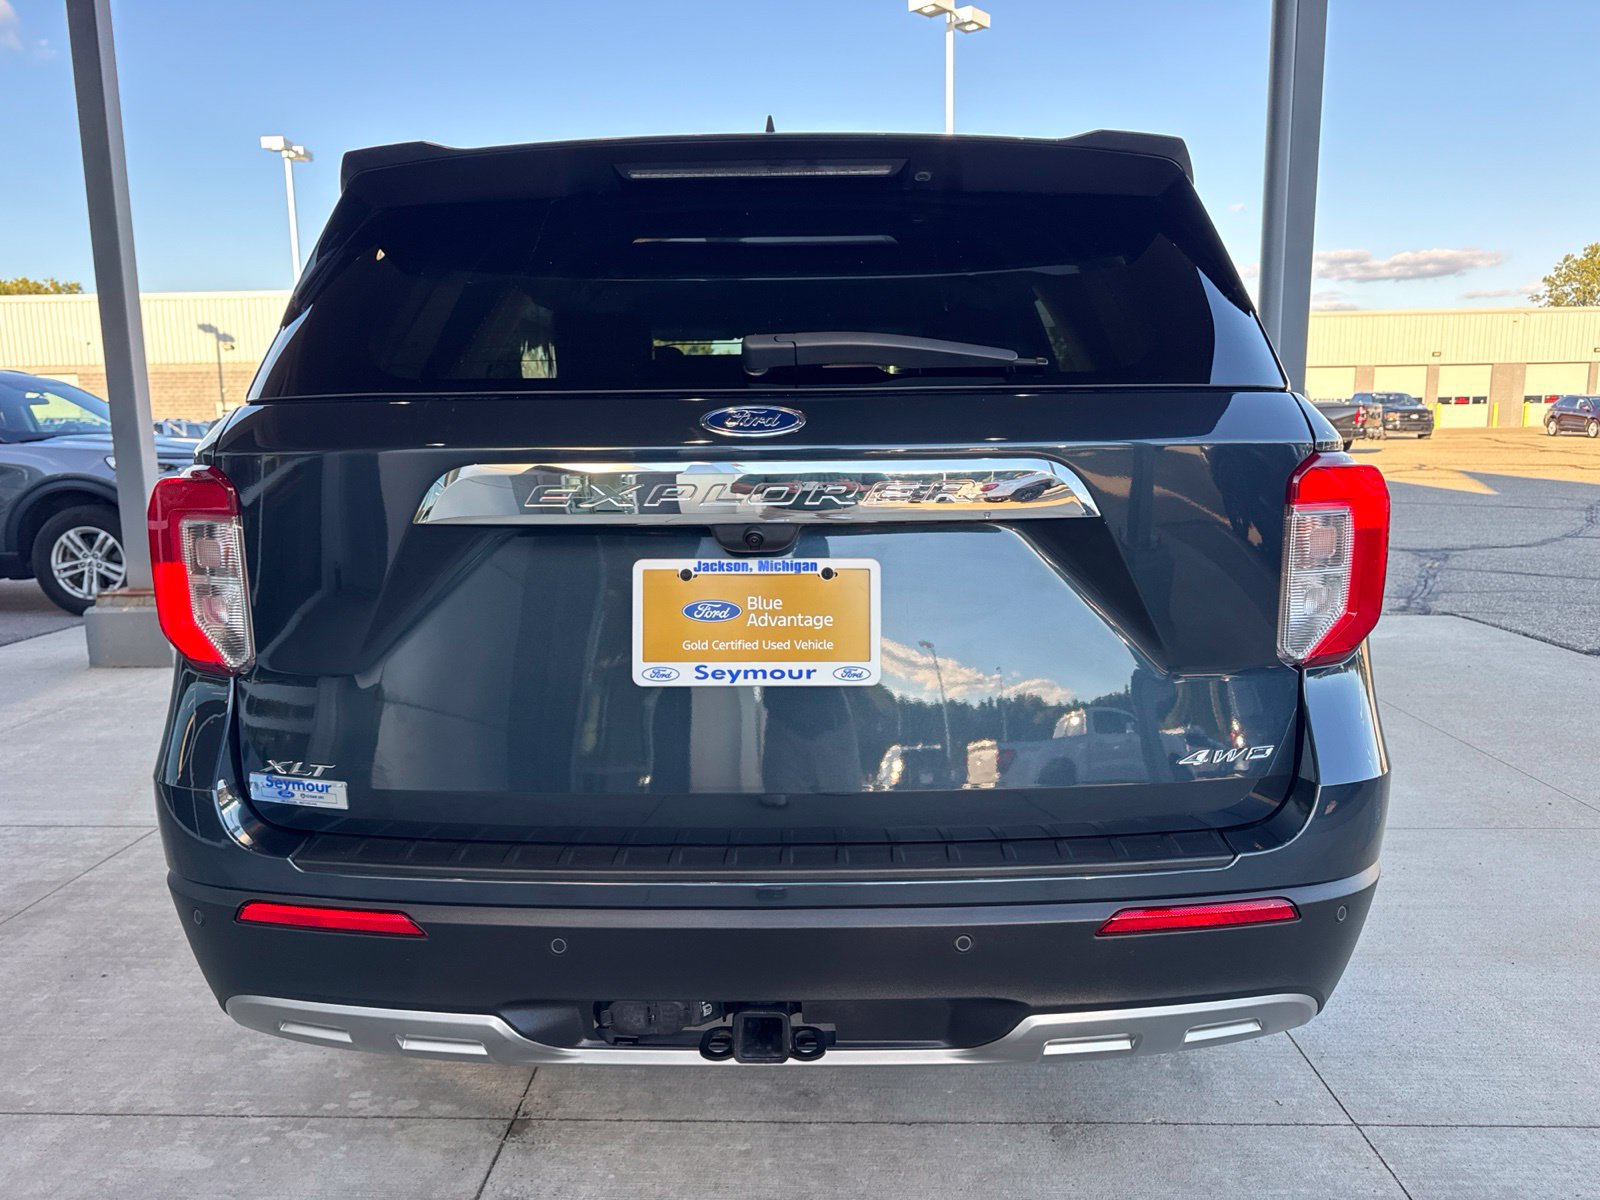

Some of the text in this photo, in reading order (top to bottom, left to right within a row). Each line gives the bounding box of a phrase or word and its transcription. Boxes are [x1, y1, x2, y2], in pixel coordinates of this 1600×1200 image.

[725, 410, 781, 427] Ford
[524, 480, 979, 508] EXPLORER
[693, 559, 818, 574] Jackson, Michigan
[694, 602, 730, 620] Ford
[747, 596, 783, 611] Blue
[746, 613, 834, 630] Advantage
[682, 639, 834, 651] Gold Certified Used Vehicle
[649, 668, 673, 680] Ford
[694, 664, 817, 684] Seymour
[840, 667, 864, 679] Ford
[1177, 744, 1275, 766] 4WD
[260, 759, 337, 777] XLT
[265, 774, 332, 794] Seymour
